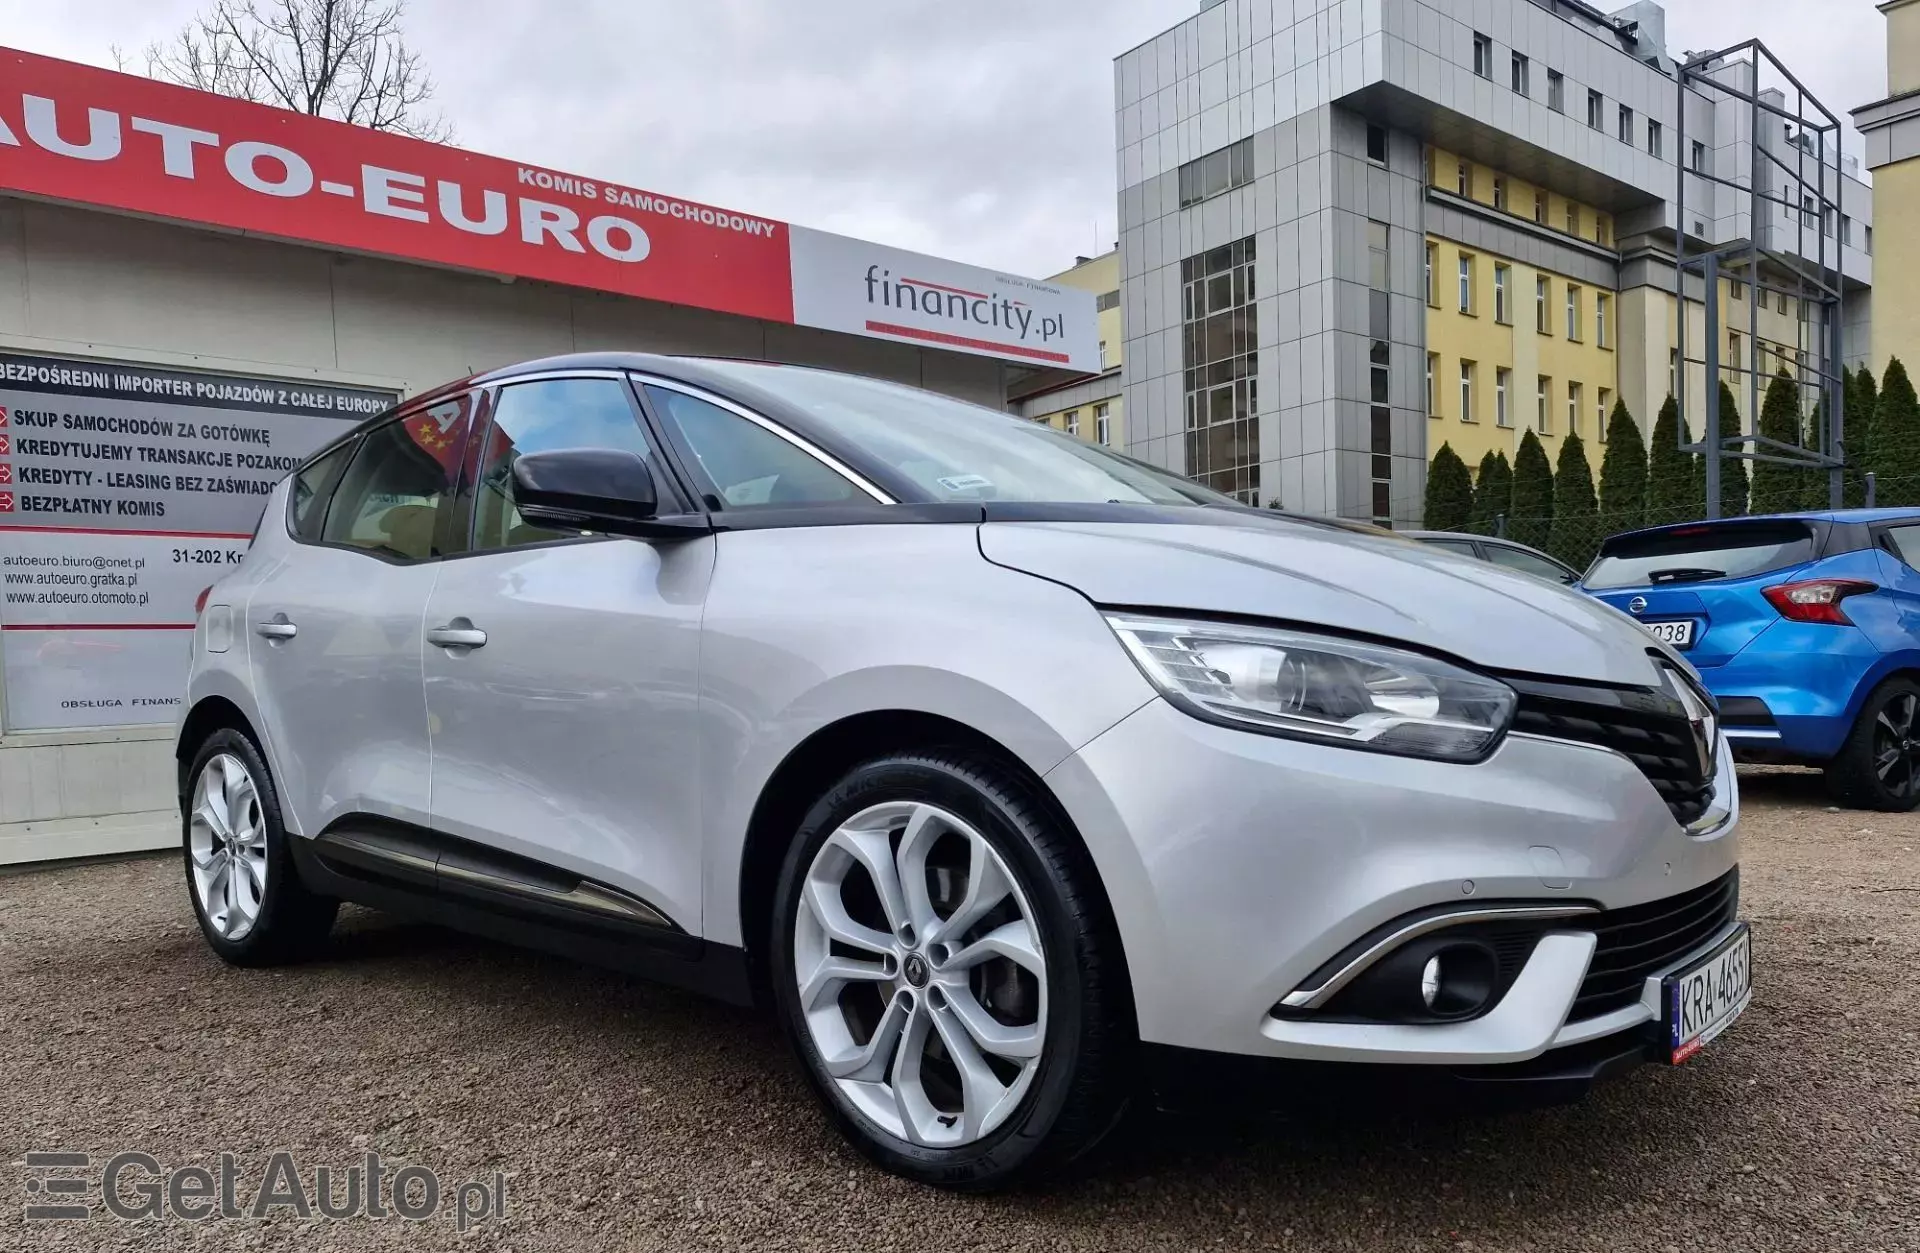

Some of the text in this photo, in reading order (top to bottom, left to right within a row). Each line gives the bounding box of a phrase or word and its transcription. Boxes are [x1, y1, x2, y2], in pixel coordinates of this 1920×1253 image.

[518, 167, 775, 238] KOMIS SAMOCHODOWY
[864, 264, 1065, 341] financity.pl
[0, 363, 388, 413] BEZPOŚREDNI IMPORTER POJAZDÓW Z CAŁEJ EUROPY
[14, 409, 271, 447] SKUP SAMOCHODÓW ZA GOTÓWKĘ
[16, 438, 133, 460] KREDYTUJEMY
[137, 447, 233, 467] TRANSAKCJE
[18, 467, 93, 485] KREDYTY
[107, 472, 171, 490] LEASING
[175, 476, 204, 492] BEZ
[21, 495, 165, 516] BEZPŁATNY KOMIS
[3, 555, 145, 569] autoeuro.biuro@onet.pl
[172, 548, 222, 563] 31-202
[4, 572, 137, 588] www.autoeuro.gratka.pl
[6, 591, 149, 606] www.autoeuro.otomoto.pl
[60, 697, 181, 708] OBSŁUGA FINANS
[1681, 968, 1714, 1038] KRA
